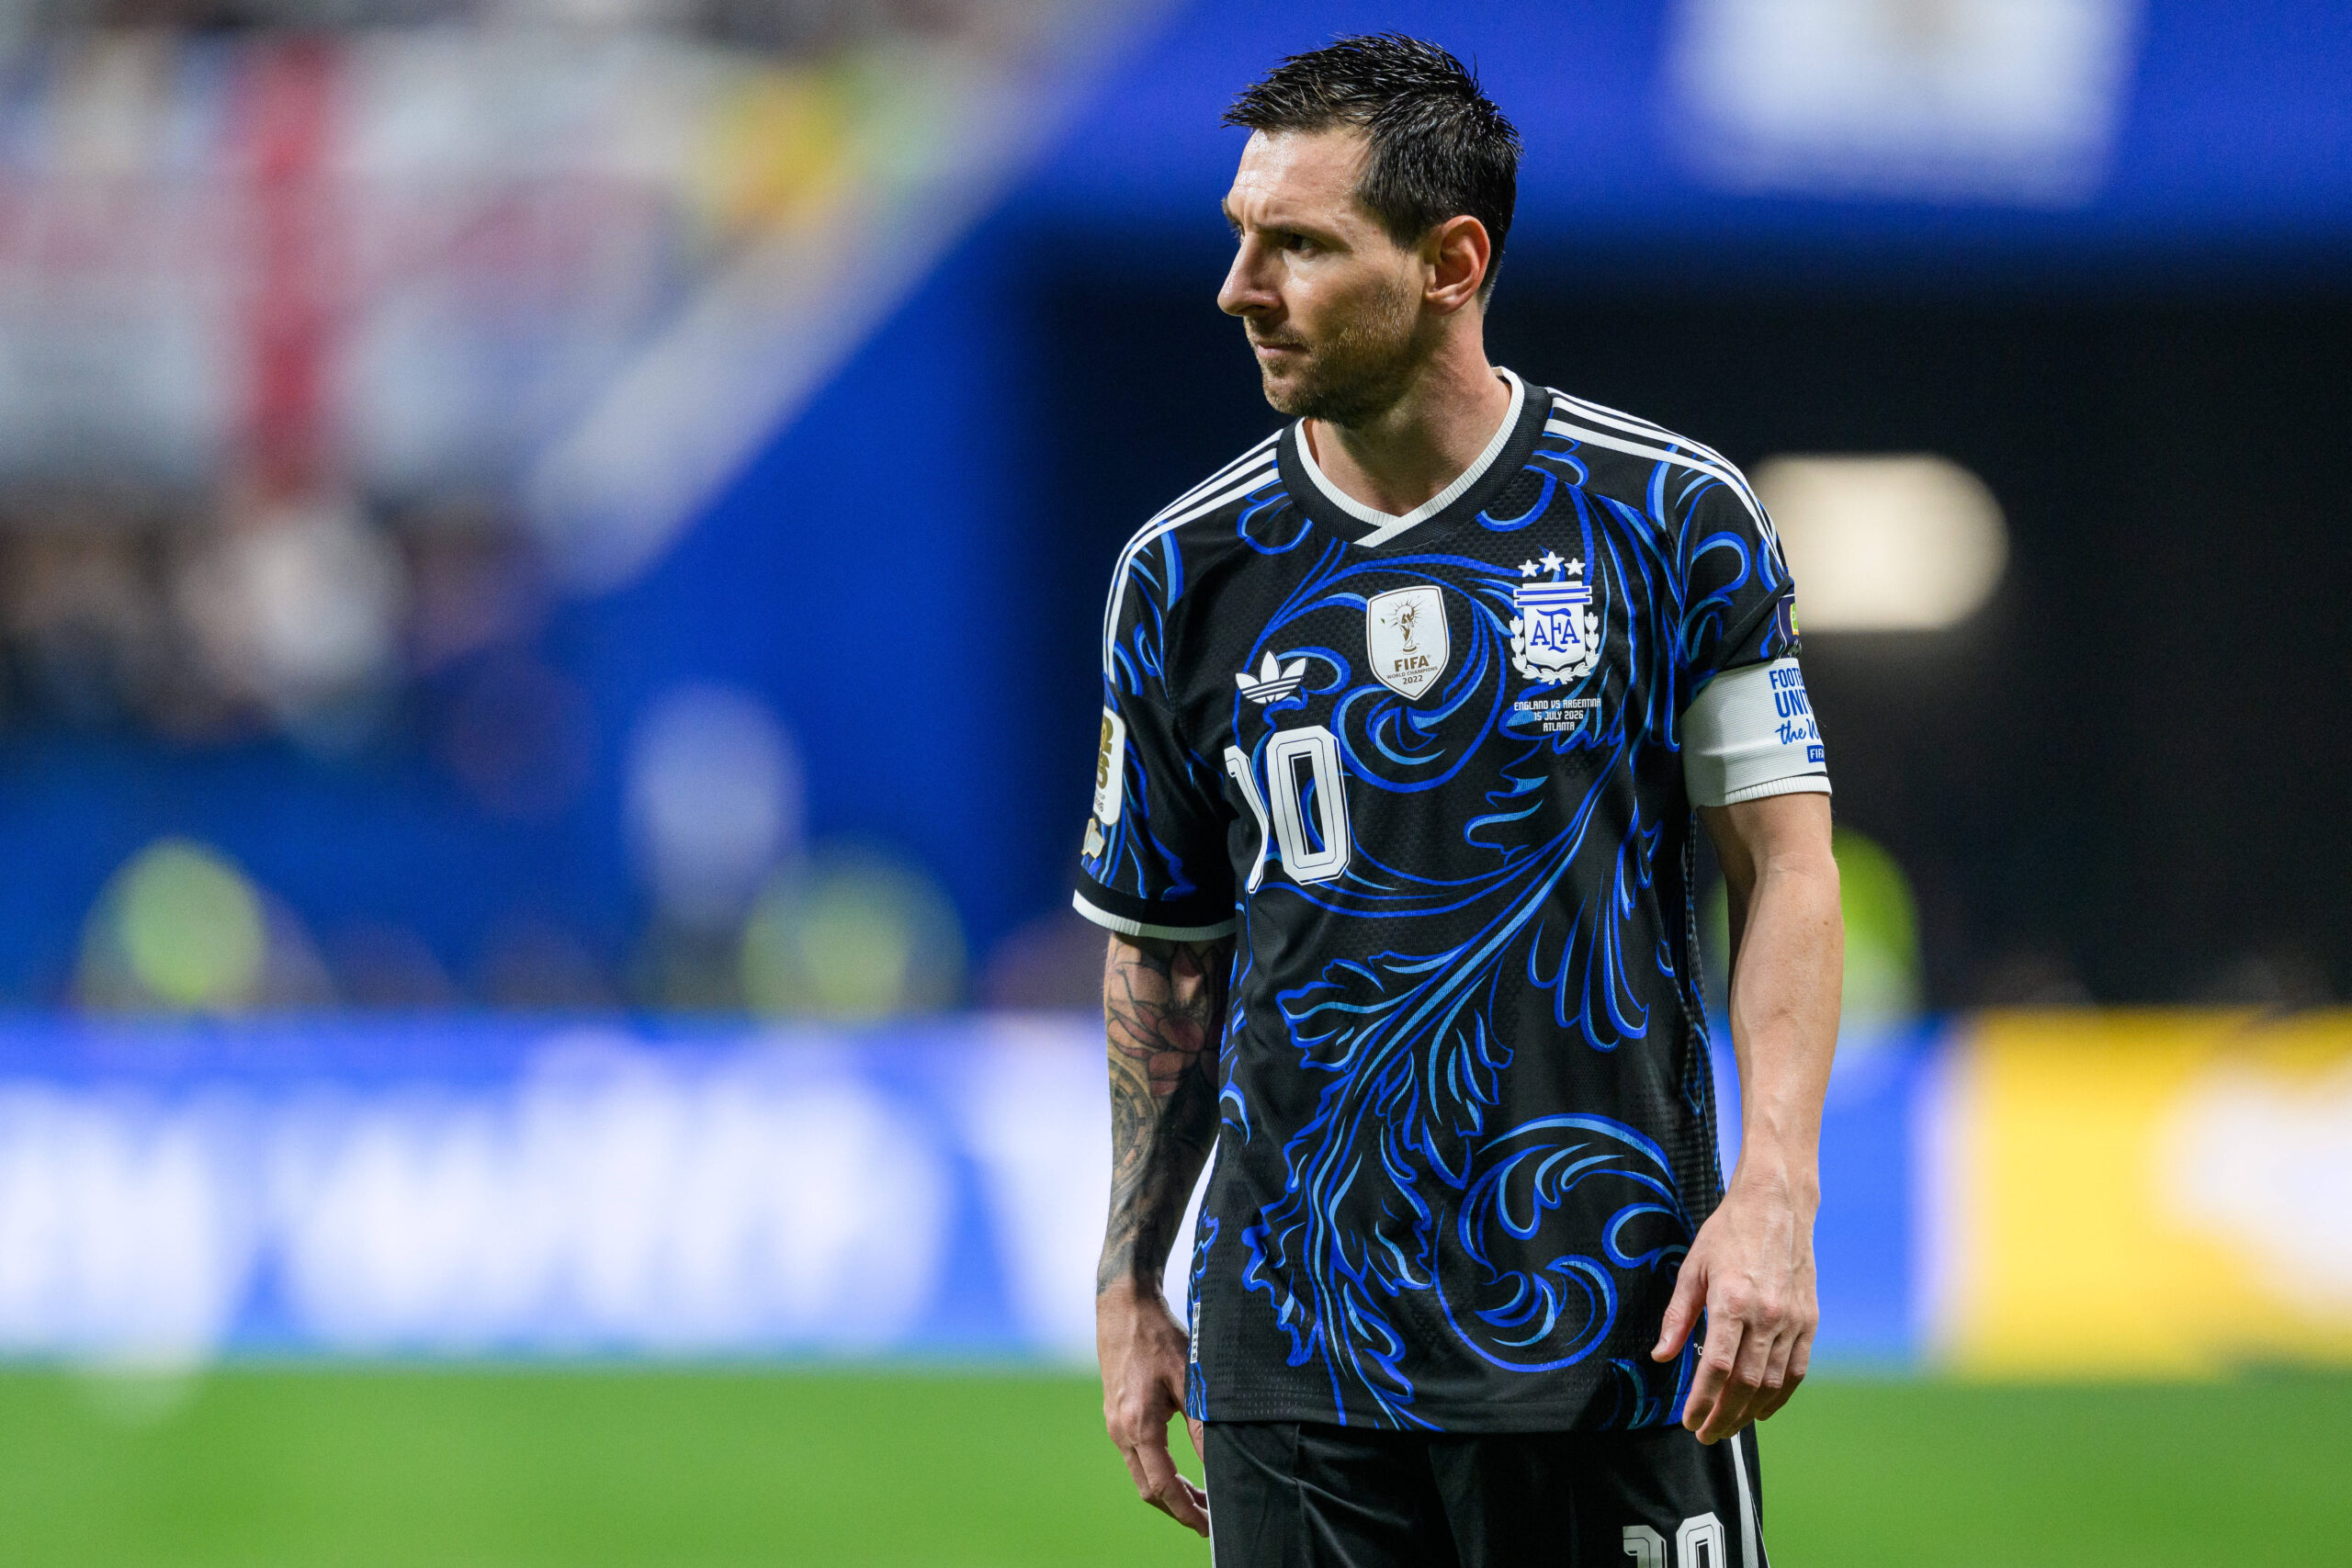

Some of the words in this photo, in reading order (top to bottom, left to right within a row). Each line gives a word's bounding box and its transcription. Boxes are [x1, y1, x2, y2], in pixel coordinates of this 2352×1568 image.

[1530, 607, 1581, 653] AFA
[1394, 655, 1430, 672] FIFA
[1386, 671, 1406, 680] WORLD
[1407, 666, 1439, 676] CHAMPIONS
[1402, 674, 1423, 685] 2022
[1513, 700, 1549, 711] ENGLAND
[1550, 699, 1561, 709] VS
[1563, 697, 1601, 709] ARGENTINA
[1533, 711, 1543, 721] 15
[1544, 711, 1562, 721] JULY
[1564, 710, 1584, 720] 2026
[1543, 721, 1576, 732] ATLANTA
[1774, 719, 1806, 745] the
[1224, 725, 1351, 894] 10
